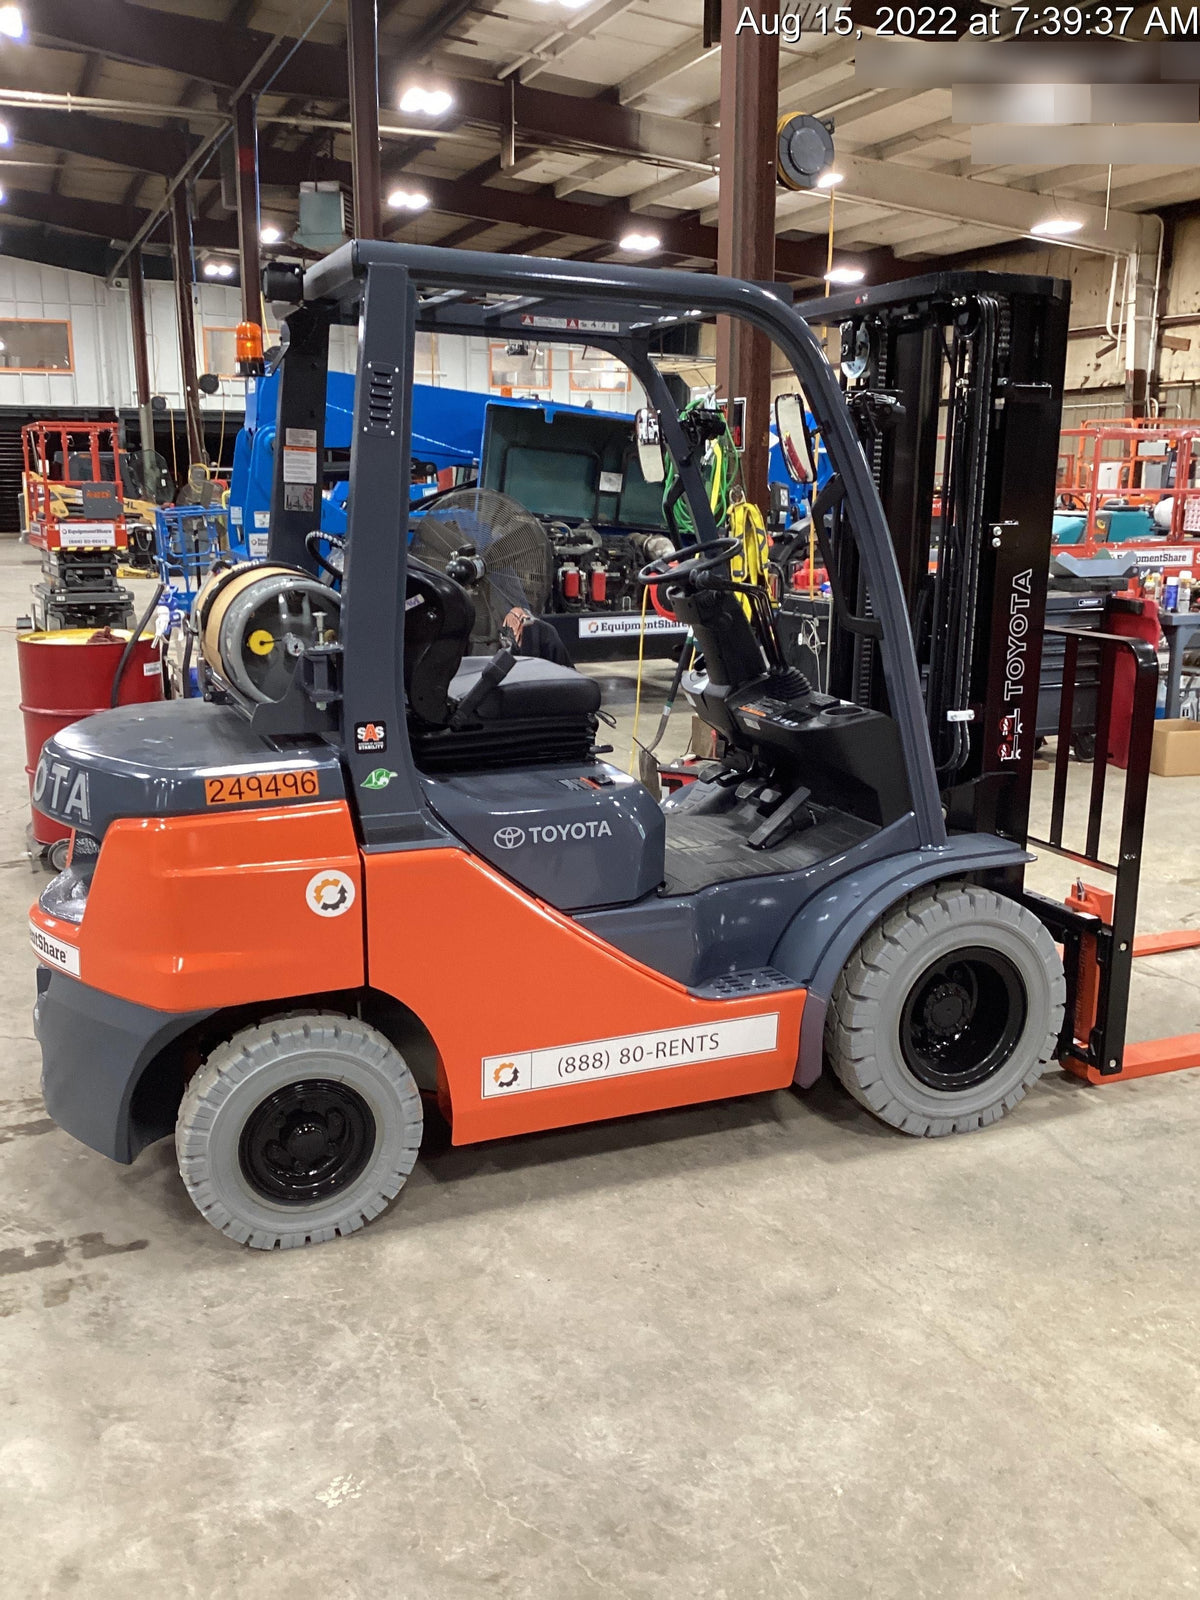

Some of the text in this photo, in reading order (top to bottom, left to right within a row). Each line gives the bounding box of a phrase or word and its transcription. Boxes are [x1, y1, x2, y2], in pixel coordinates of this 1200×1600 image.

[1004, 568, 1033, 701] TOYOTA
[357, 723, 385, 741] SAS
[208, 771, 317, 803] 249496
[528, 820, 612, 843] TOYOTA
[557, 1033, 720, 1077] (888) 80-RENTS
